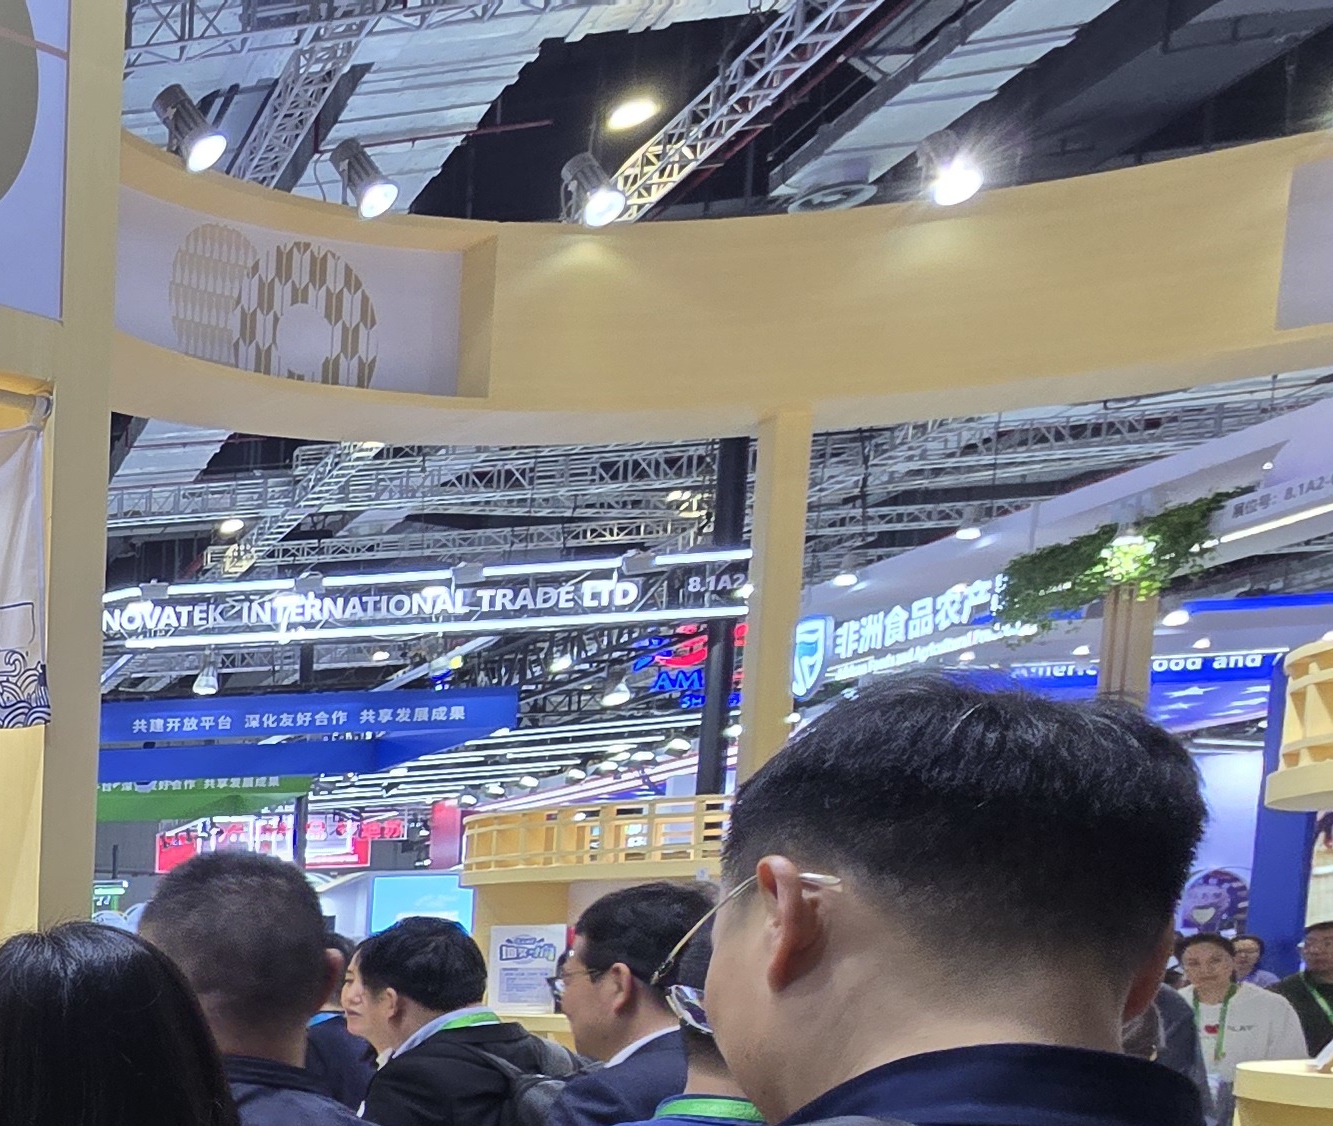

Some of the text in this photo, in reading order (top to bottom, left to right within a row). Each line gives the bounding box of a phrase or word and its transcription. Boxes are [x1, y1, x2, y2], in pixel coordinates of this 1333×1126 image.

[102, 603, 225, 633] NOVATEK
[242, 588, 471, 625] INTERNATIONAL
[476, 584, 575, 612] TRADE
[581, 579, 639, 608] LTD
[1152, 656, 1202, 672] ood
[132, 706, 466, 734] 共建开放平台 深化友好合作 共享发展成果
